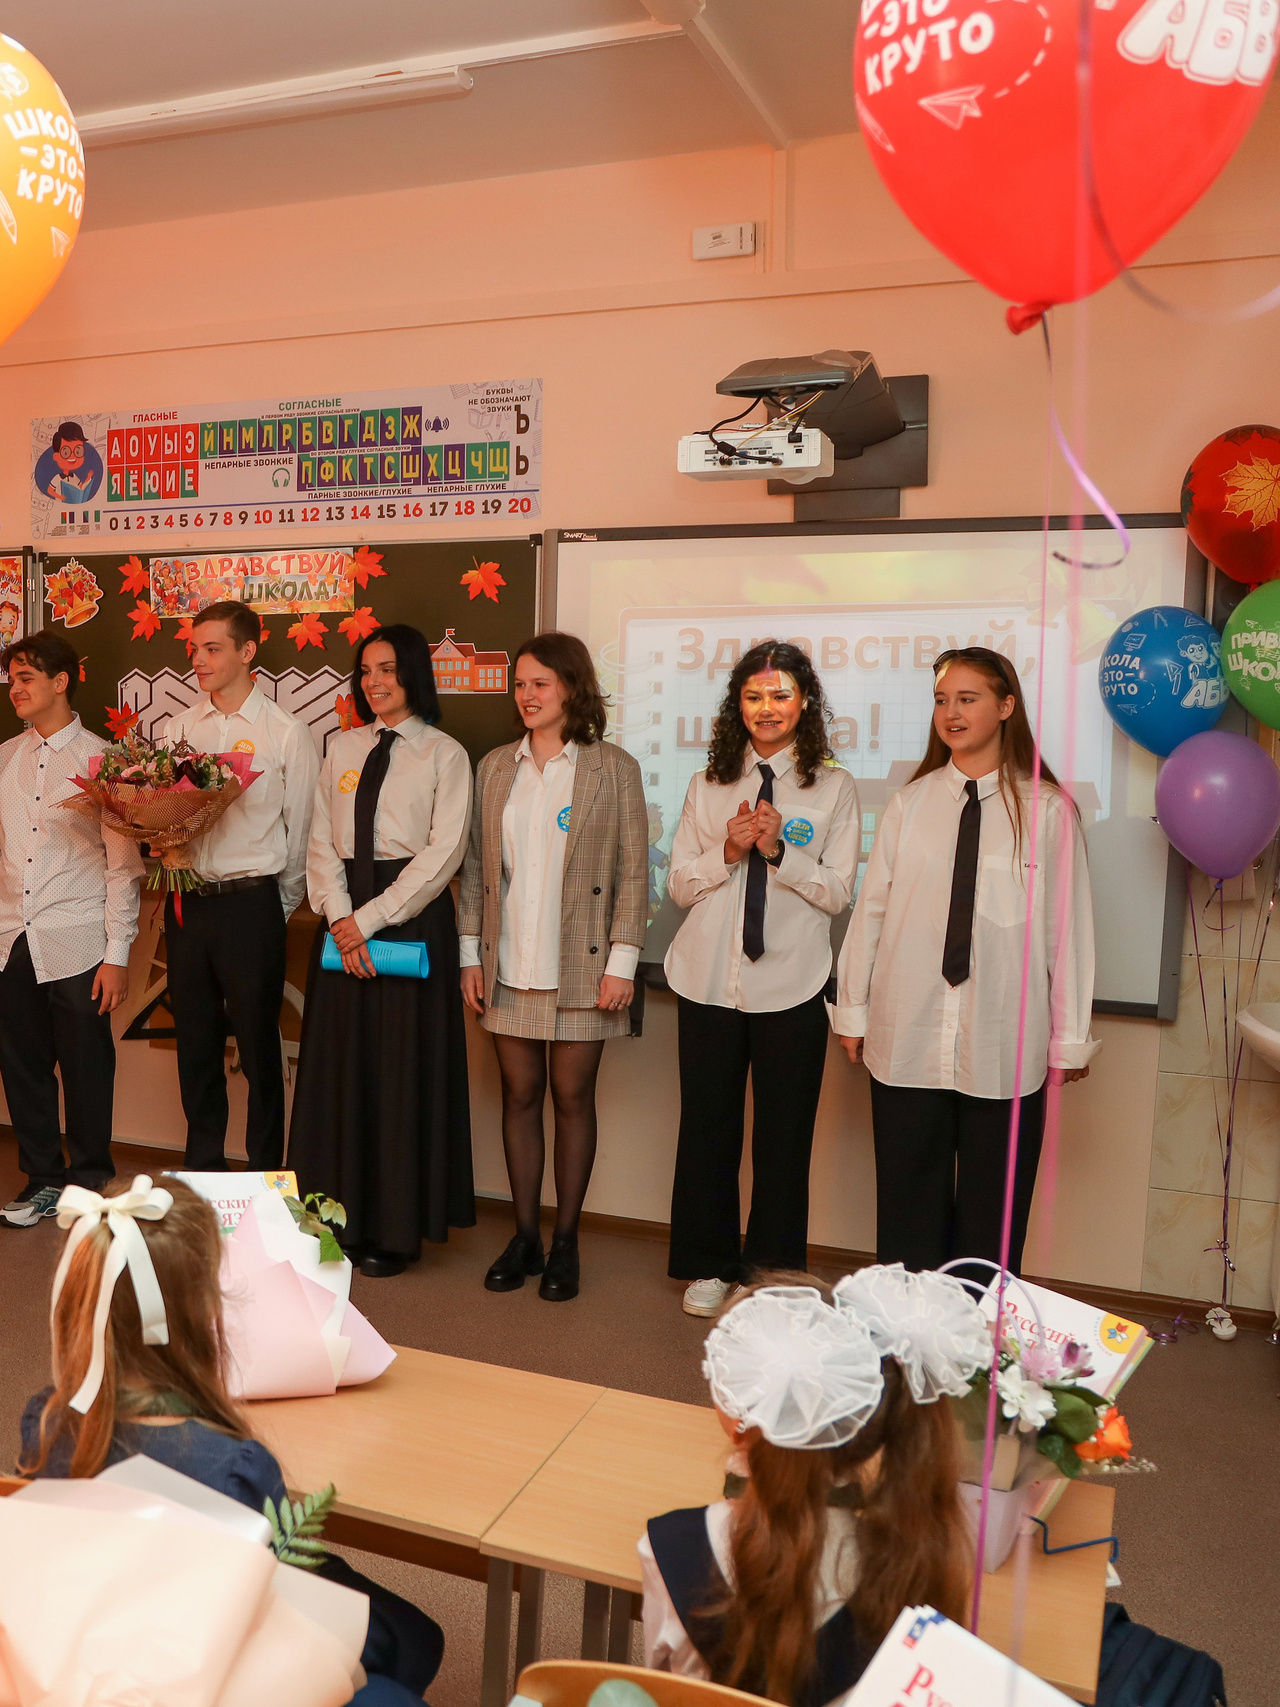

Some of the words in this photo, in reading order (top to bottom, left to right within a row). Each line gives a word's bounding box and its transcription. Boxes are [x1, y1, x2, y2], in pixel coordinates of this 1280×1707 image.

[865, 11, 994, 96] КРУТО
[17, 168, 83, 220] КРУТО
[486, 387, 514, 395] БУКВЫ
[278, 398, 342, 411] СОГЛАСНЫЕ
[480, 394, 531, 405] ОБОЗНАЧАЮТ
[486, 405, 512, 413] ЗВУКИ
[133, 411, 178, 423] ГЛАСНЫЕ
[514, 404, 530, 435] Ъ
[204, 459, 252, 470] НЕПАРНЫЕ
[253, 457, 294, 468] ЗВОНКИЕ
[515, 445, 530, 476] Ь
[308, 491, 341, 500] ПАРНЫЕ
[342, 487, 413, 498] ЗВОНКИЕ/ГЛУХИЕ
[427, 485, 473, 493] НЕПАРНЫЕ
[475, 483, 507, 492] ГЛУХИЕ
[109, 517, 119, 530] 0
[124, 517, 131, 530] 1
[136, 516, 145, 529] 2
[150, 515, 159, 529] 3
[164, 514, 174, 528] 4
[179, 514, 189, 527] 5
[194, 513, 204, 527] 6
[209, 512, 219, 526] 7
[223, 512, 233, 525] 8
[238, 511, 249, 525] 9
[254, 510, 272, 524] 10
[278, 508, 295, 523] 11
[301, 507, 320, 522] 12
[326, 506, 345, 521] 13
[351, 505, 371, 520] 14
[377, 503, 396, 518] 15
[403, 502, 423, 517] 16
[429, 501, 448, 516] 17
[455, 500, 475, 515] 18
[482, 499, 502, 514] 19
[508, 498, 531, 513] 20
[1231, 631, 1280, 649] ПРИВ
